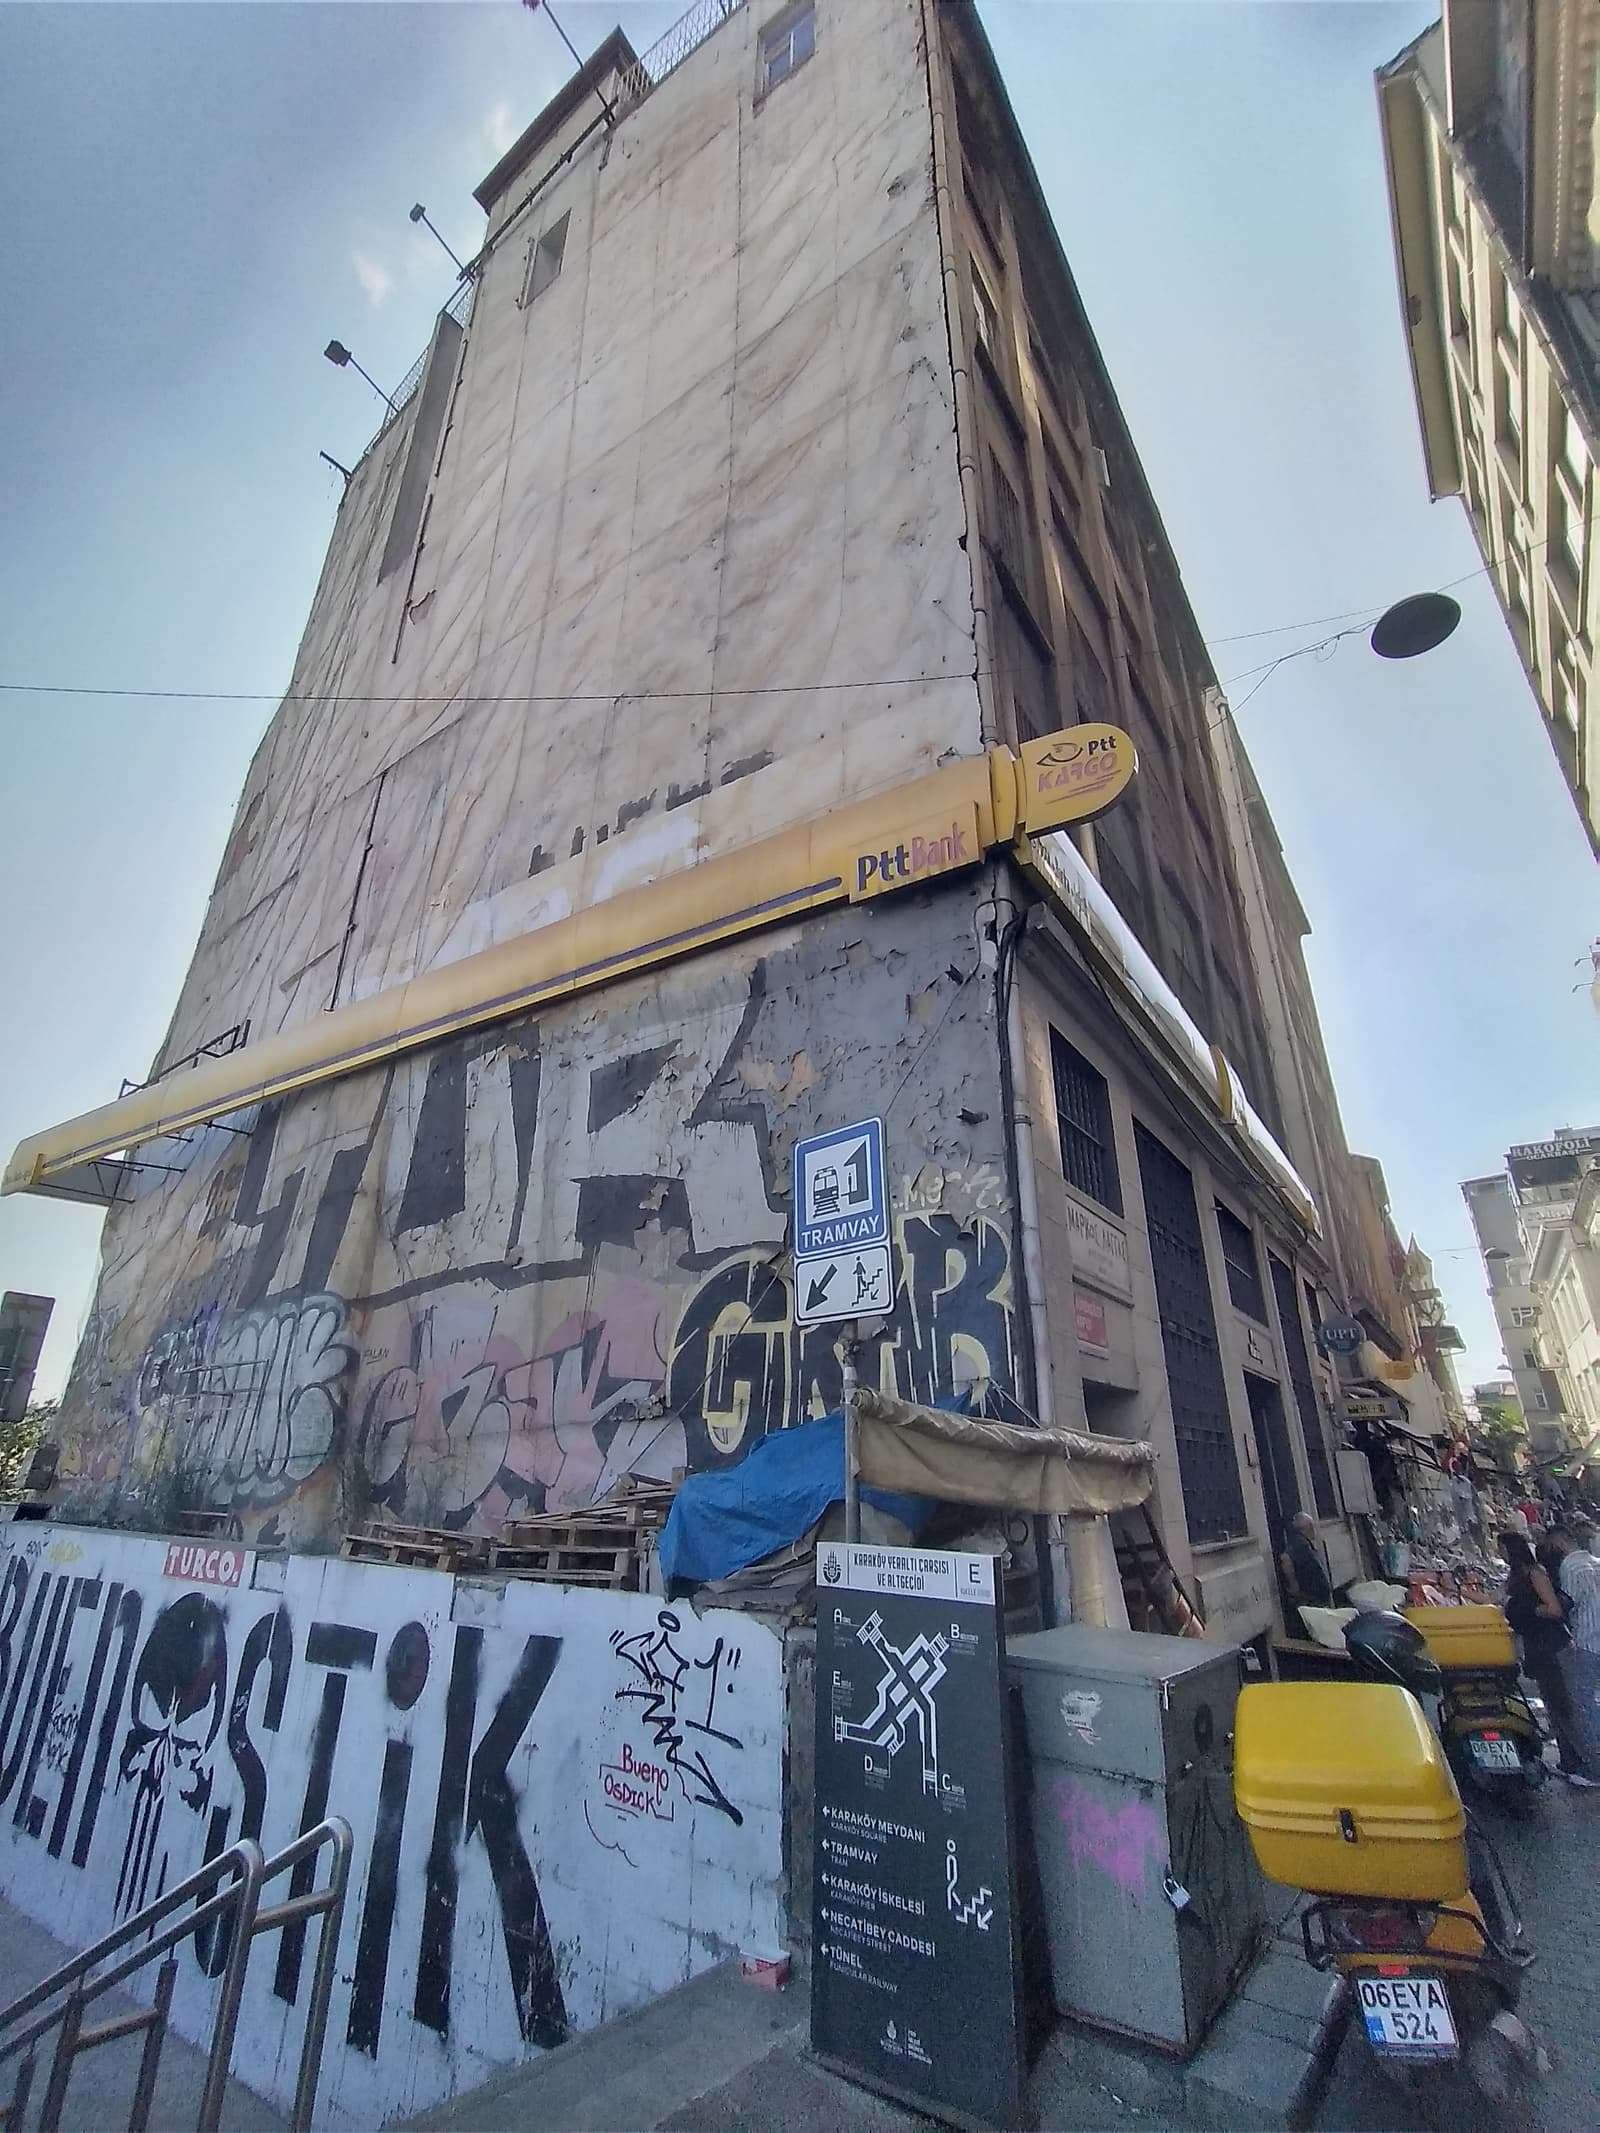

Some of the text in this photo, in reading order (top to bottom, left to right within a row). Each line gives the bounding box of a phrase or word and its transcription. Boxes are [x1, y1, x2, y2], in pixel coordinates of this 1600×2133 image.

[1087, 735, 1117, 756] Ptt
[1037, 752, 1118, 793] KARGO
[856, 822, 968, 892] PttBank
[802, 1215, 880, 1249] TRAMVAY
[1325, 1327, 1357, 1340] UPT
[854, 1552, 887, 1569] KARAKÖY
[888, 1556, 918, 1572] YERALTI
[877, 1573, 886, 1587] VE
[969, 1563, 981, 1584] E
[833, 1608, 842, 1624] A
[950, 1623, 960, 1639] B
[833, 1671, 841, 1686] E
[864, 1755, 874, 1772] D
[942, 1774, 951, 1790] C
[831, 1807, 926, 1844] KARAKÖY MEYDANI
[831, 1841, 878, 1864] TRAMVAY
[830, 1874, 925, 1916] KARAKÖY İSKELESİ
[830, 1910, 936, 1958] NECATİBEY CADDESİ
[829, 1945, 862, 1969] TÜNEL
[1391, 2012, 1439, 2040] 524
